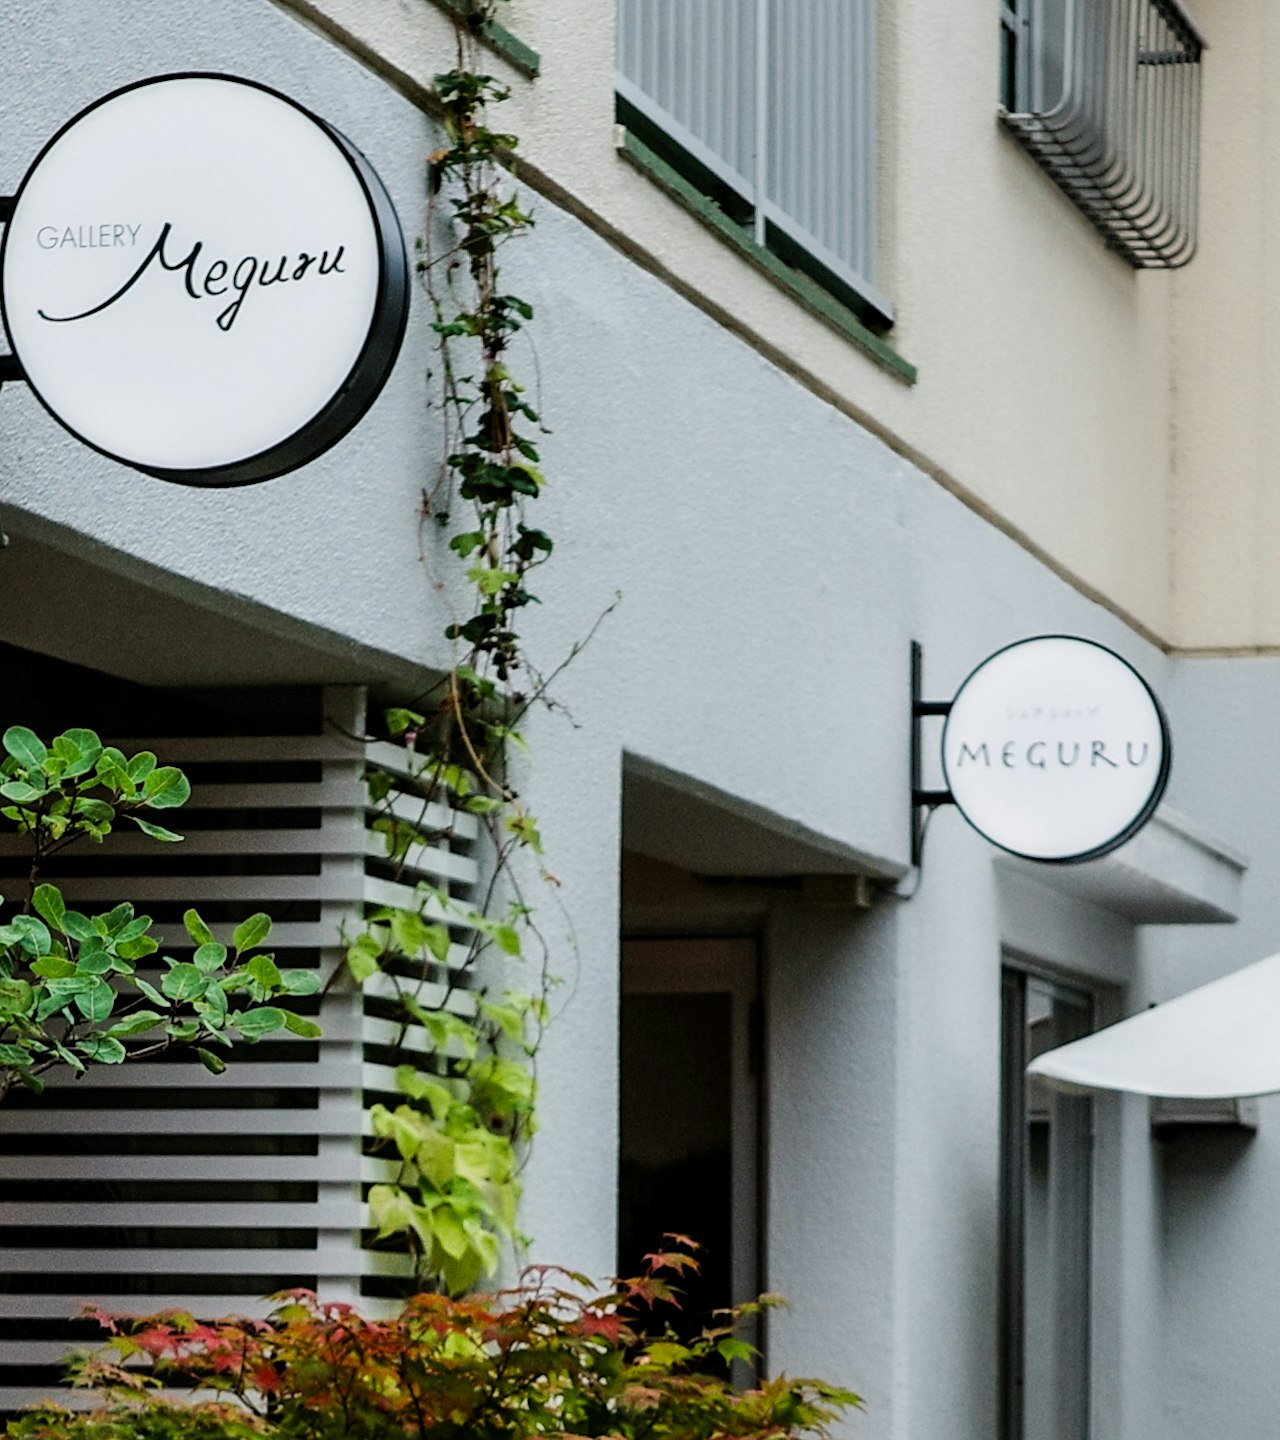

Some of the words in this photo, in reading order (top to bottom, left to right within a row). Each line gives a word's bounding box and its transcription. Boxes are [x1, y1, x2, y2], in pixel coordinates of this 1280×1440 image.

[36, 223, 142, 251] GALLERY
[37, 222, 346, 332] Meguru
[956, 740, 1150, 769] MEGURU
